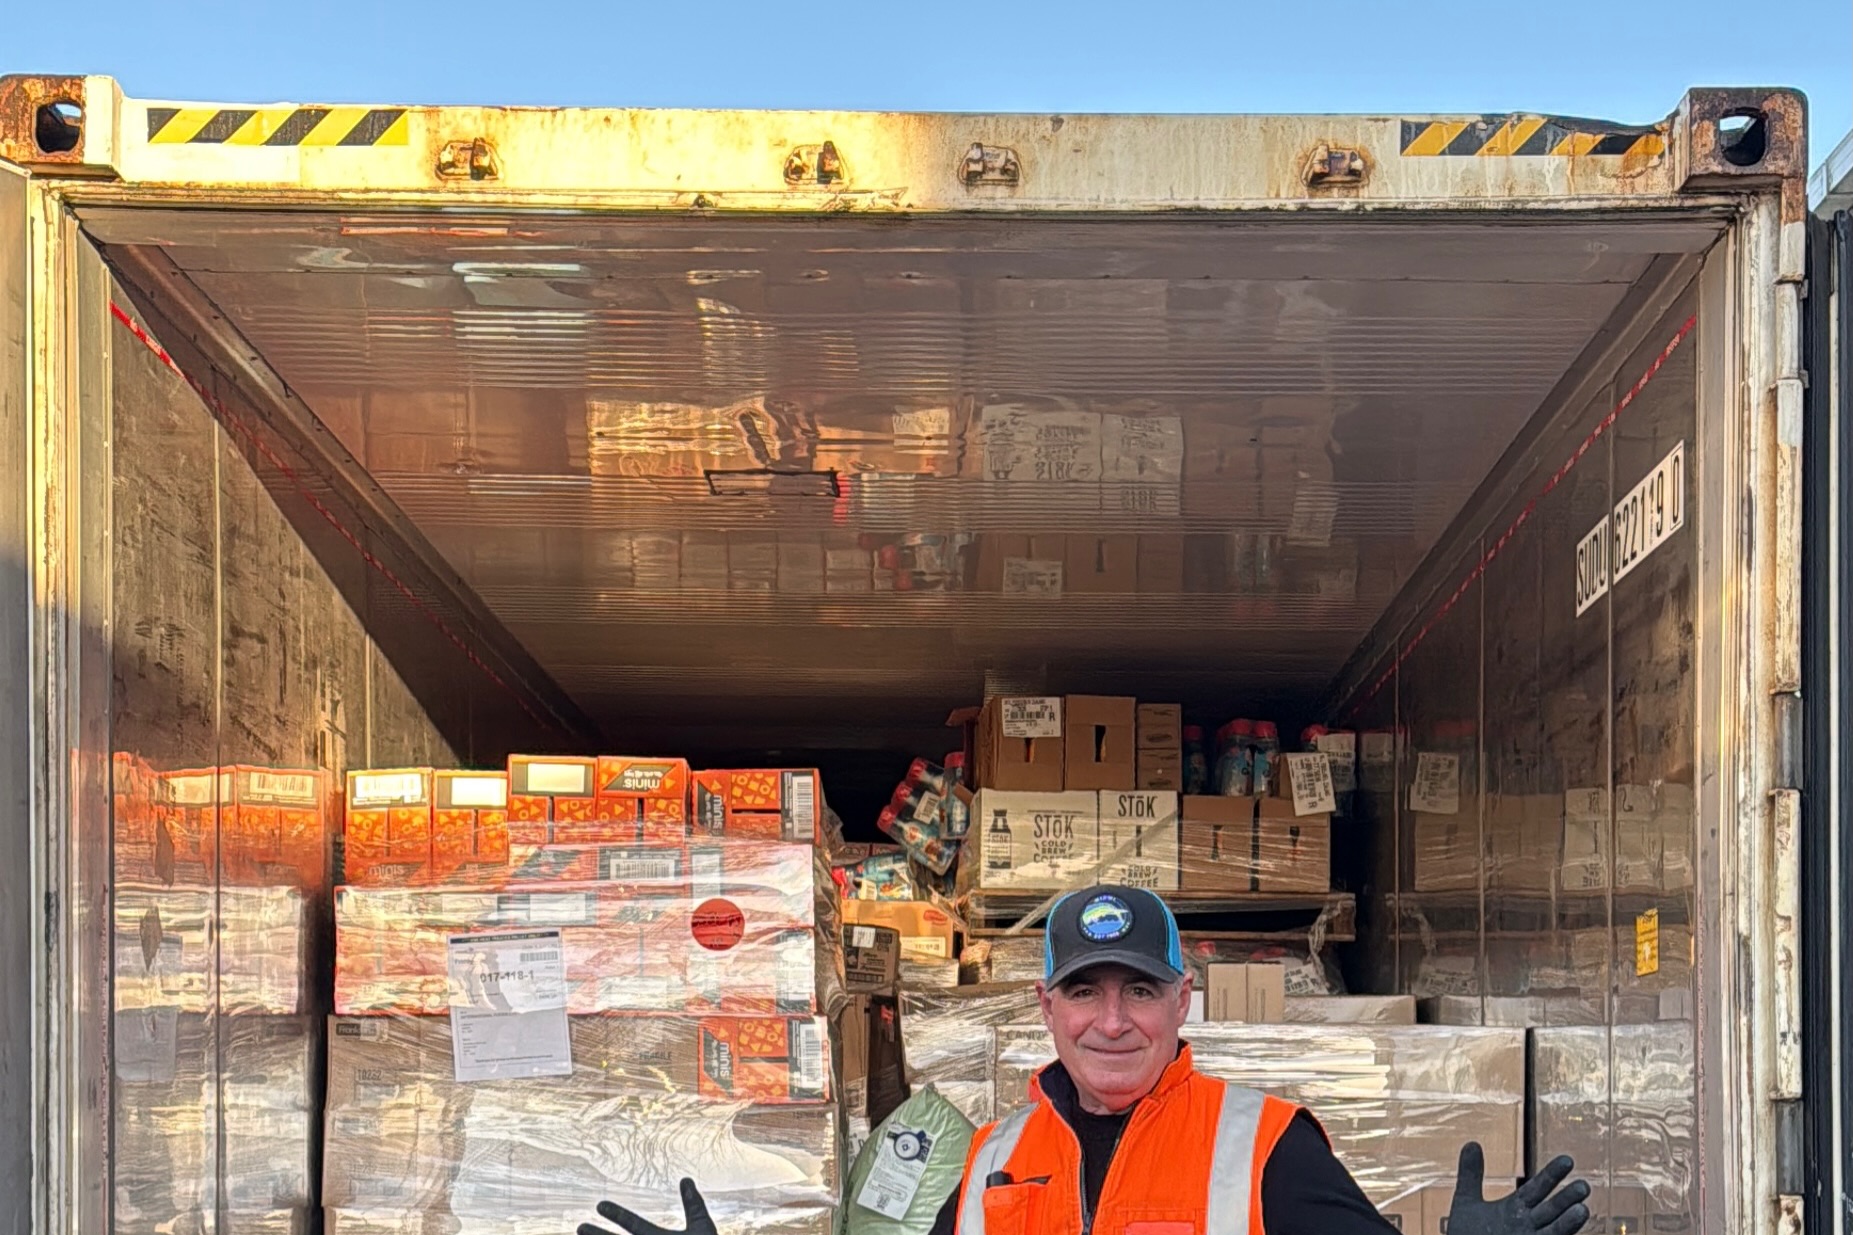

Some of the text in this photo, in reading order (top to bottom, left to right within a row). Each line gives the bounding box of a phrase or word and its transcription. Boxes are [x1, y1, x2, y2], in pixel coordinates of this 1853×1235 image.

[1577, 523, 1608, 608] SUDU
[624, 779, 661, 790] minis
[713, 794, 725, 829] minis
[1120, 877, 1159, 887] COFFEE
[480, 970, 534, 983] 017-118-1
[719, 1042, 731, 1078] minis
